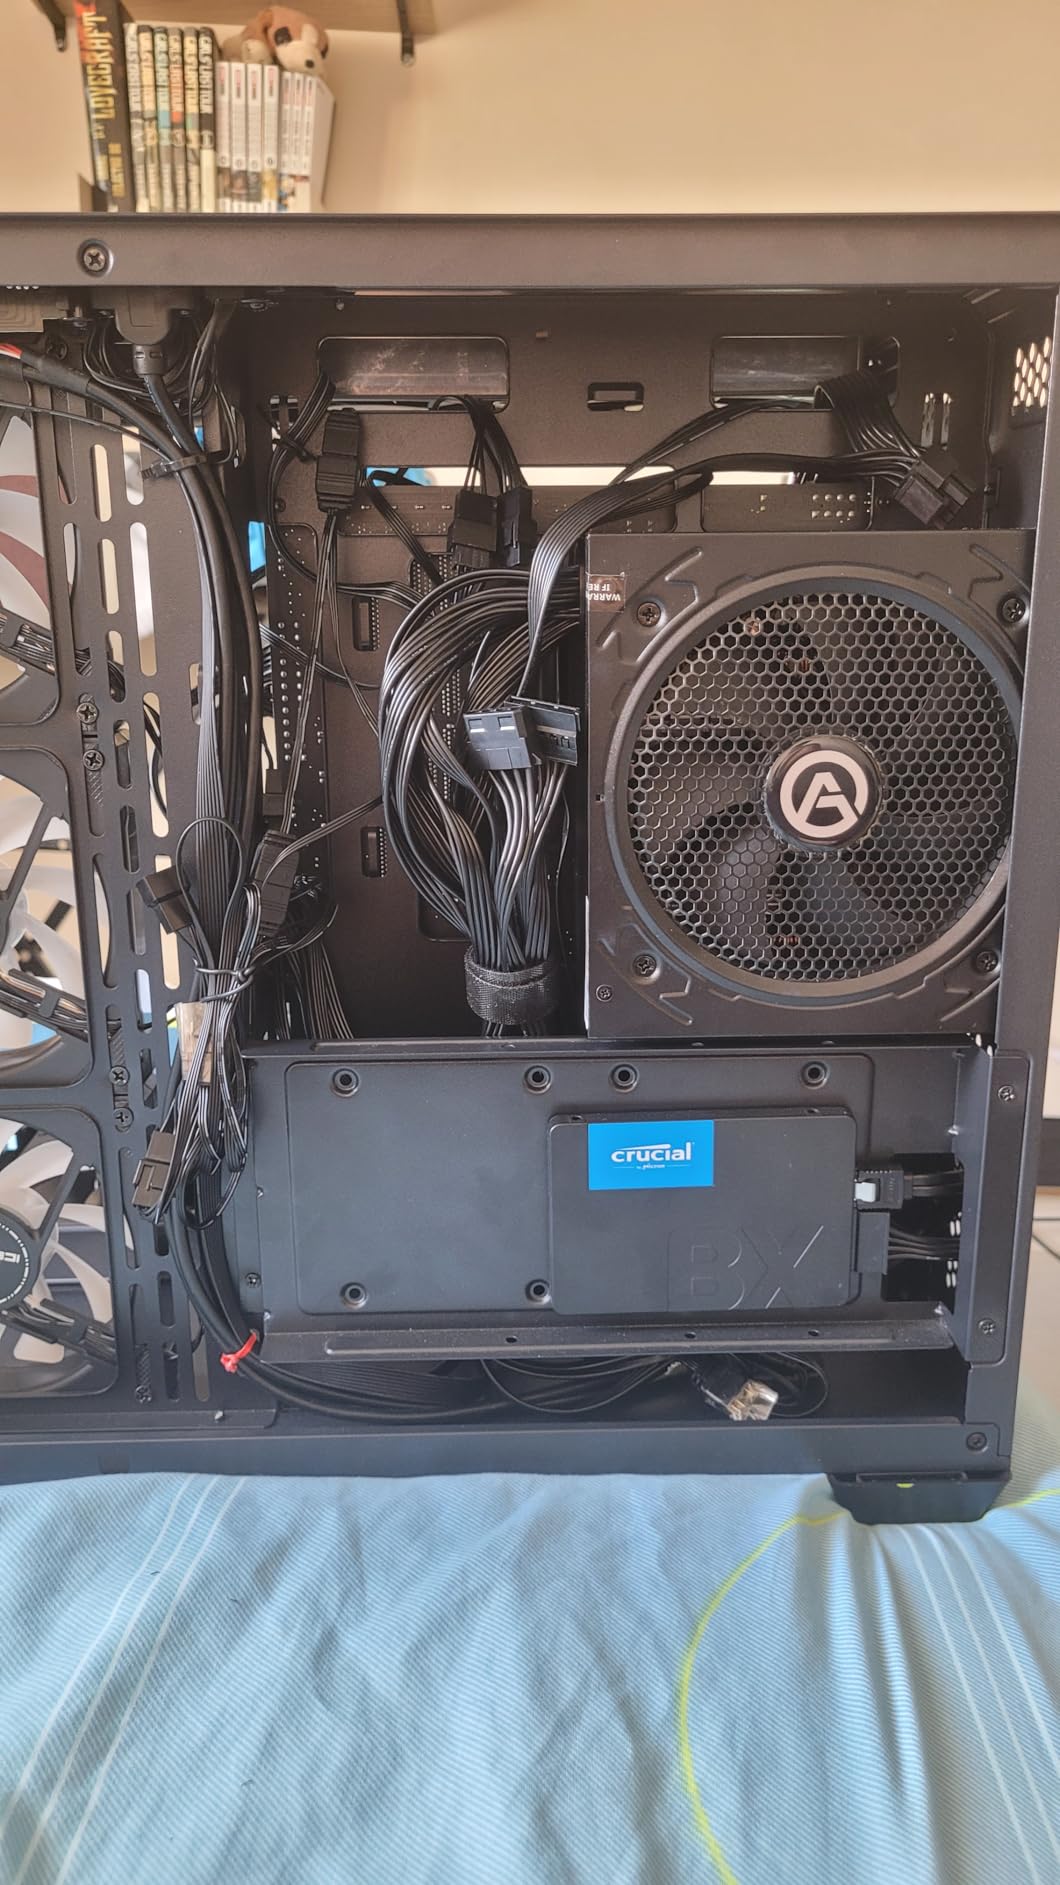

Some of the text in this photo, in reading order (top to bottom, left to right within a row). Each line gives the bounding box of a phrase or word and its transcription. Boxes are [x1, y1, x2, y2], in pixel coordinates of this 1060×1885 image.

[82, 11, 118, 120] LOVECRAFT
[585, 592, 621, 602] WARRA
[601, 583, 610, 591] IF
[610, 1141, 692, 1163] crucial
[667, 1225, 824, 1311] BX
